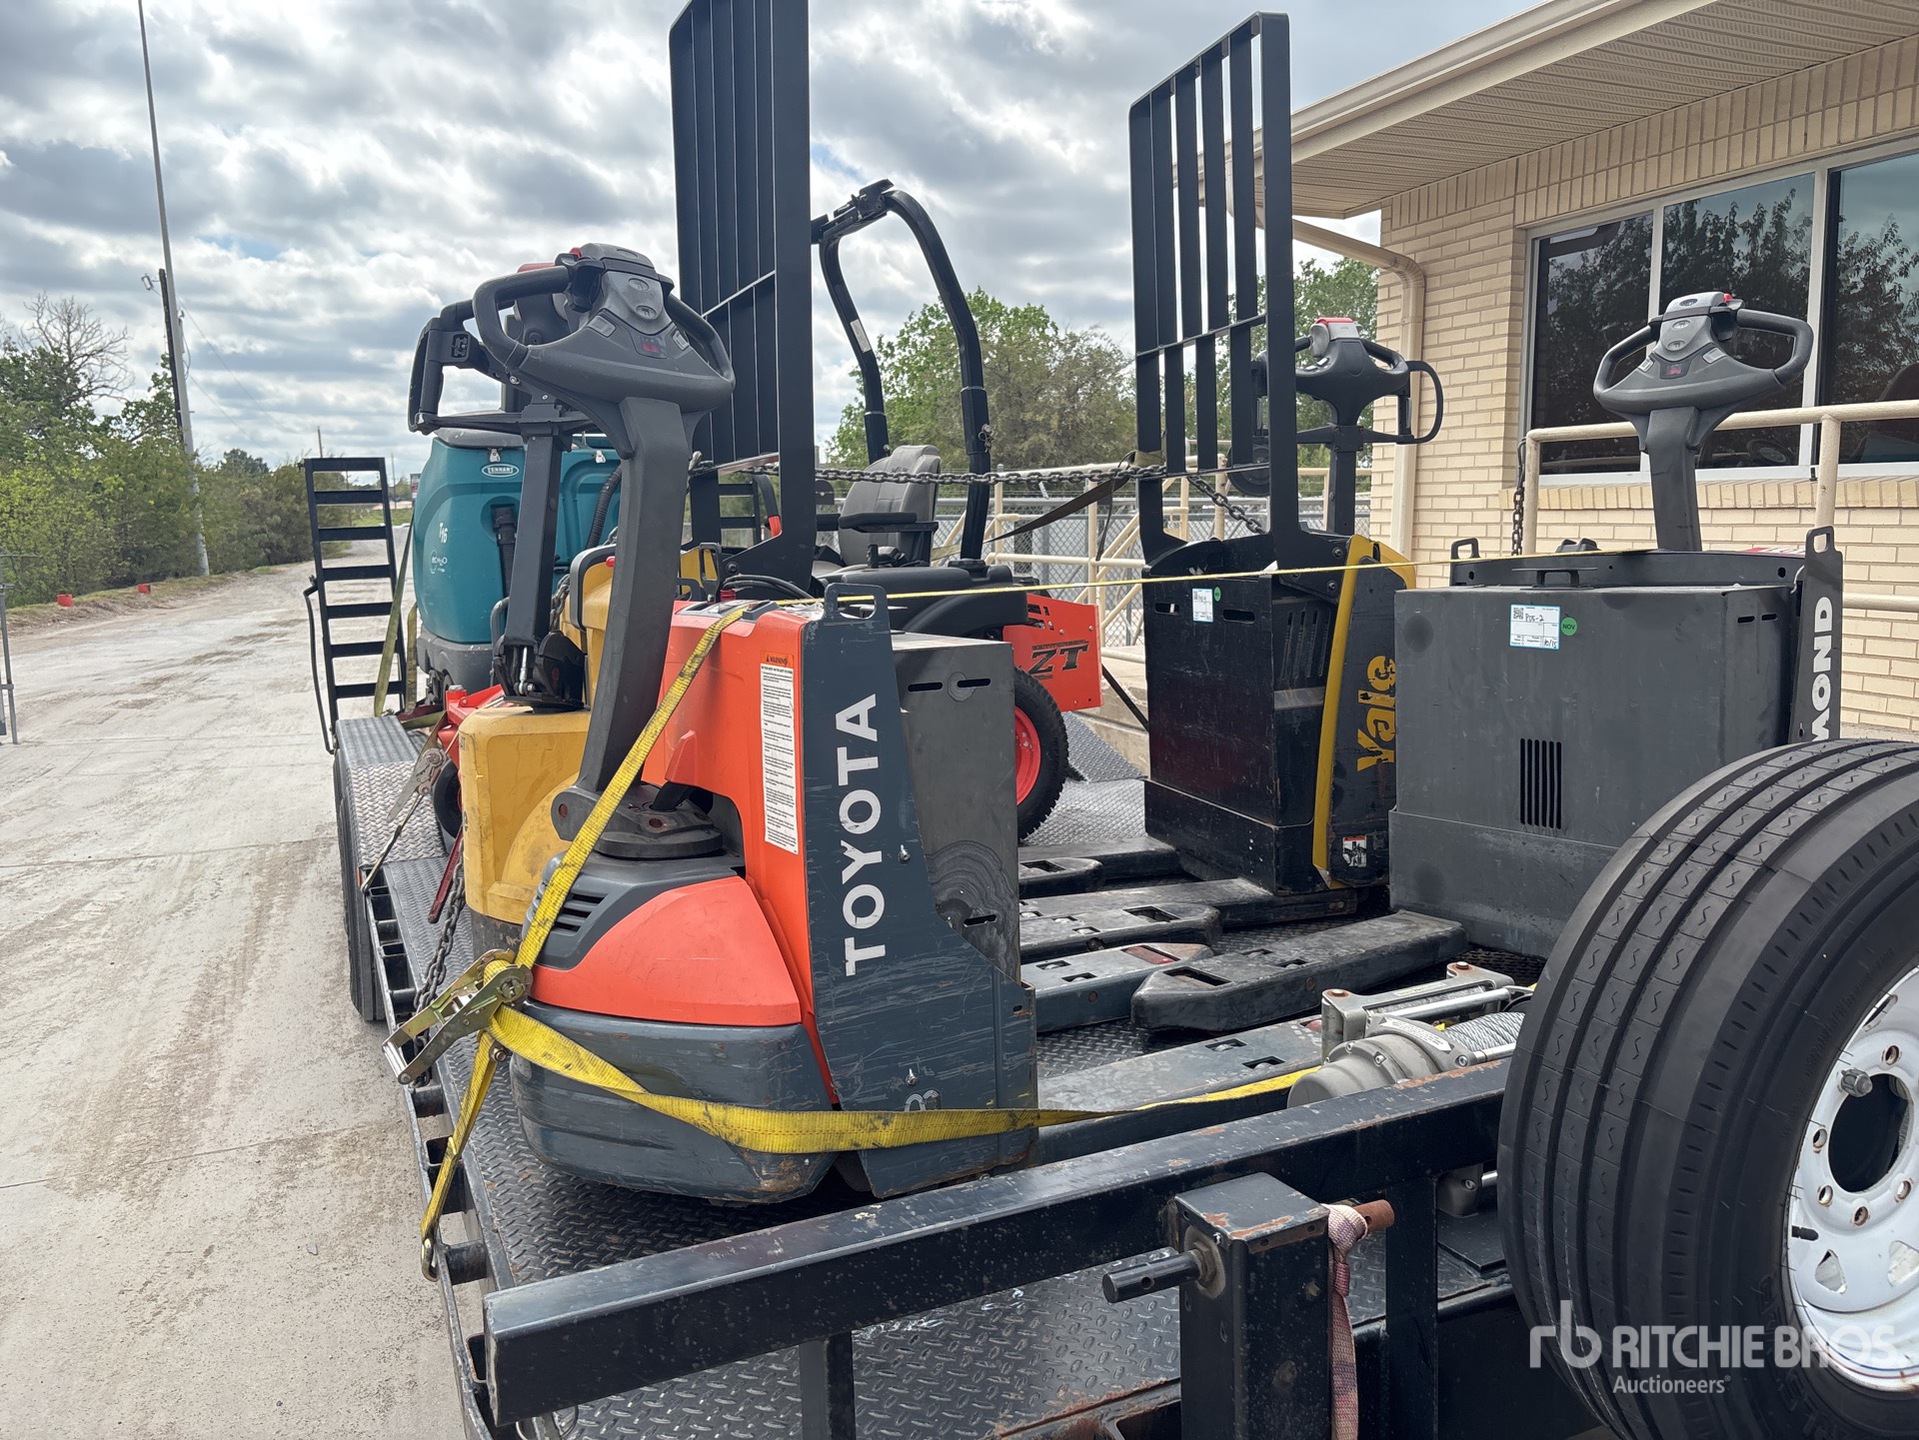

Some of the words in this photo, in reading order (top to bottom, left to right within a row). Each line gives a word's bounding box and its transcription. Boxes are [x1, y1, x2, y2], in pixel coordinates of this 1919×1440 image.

[1028, 644, 1089, 675] ZT
[1562, 623, 1576, 631] NOV
[1357, 655, 1396, 772] Yale
[835, 693, 886, 977] TOYOTA
